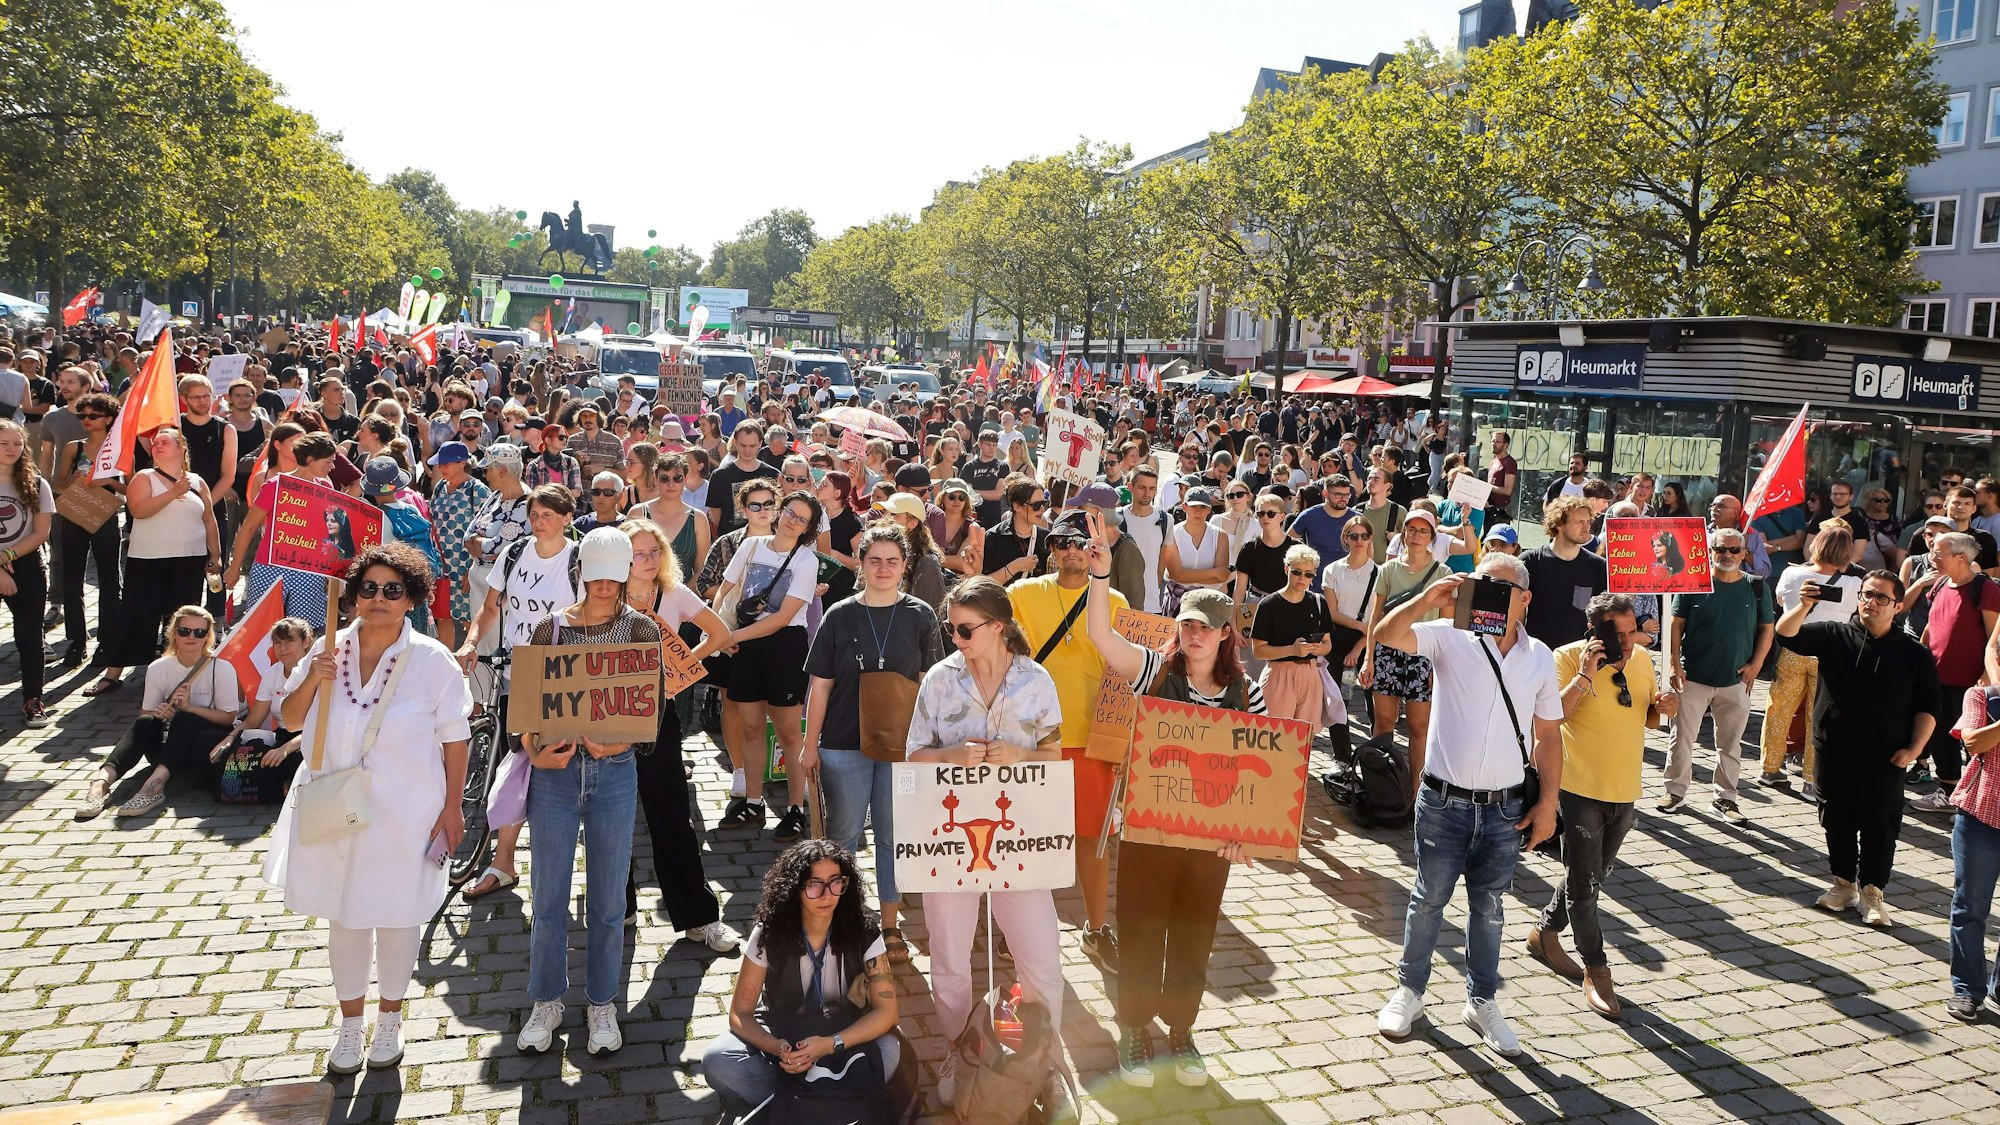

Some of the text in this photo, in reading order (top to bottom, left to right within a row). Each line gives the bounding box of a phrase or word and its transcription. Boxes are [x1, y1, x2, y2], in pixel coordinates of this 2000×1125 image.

[560, 287, 573, 296] für
[575, 288, 591, 297] das
[595, 290, 622, 299] Leben
[660, 364, 680, 376] GEGEN
[1570, 359, 1637, 376] Heumarkt
[1912, 376, 1975, 396] Heumarkt
[668, 389, 701, 402] FEMINISMUS
[1052, 415, 1068, 428] MY
[1045, 458, 1061, 475] MY
[278, 490, 308, 507] Frau
[276, 511, 307, 528] Leben
[274, 530, 318, 550] Freiheit
[1609, 531, 1634, 543] Frau
[1609, 547, 1636, 558] Leben
[516, 567, 544, 589] MY
[1610, 564, 1648, 576] Freiheit
[515, 622, 533, 643] MY
[1118, 613, 1176, 635] FÜRS LE
[545, 653, 580, 679] MY
[586, 648, 660, 676] UTERUS
[687, 661, 702, 675] IS
[543, 684, 655, 721] MY RULES
[1101, 693, 1130, 711] ARM
[1158, 721, 1283, 752] DON'T FUCK
[1149, 748, 1238, 770] WITH OUR
[936, 766, 991, 786] KEEP
[997, 765, 1046, 787] OUT!
[1149, 775, 1255, 805] FREEDOM!
[896, 834, 1075, 860] PRIVATE PROPERTY
